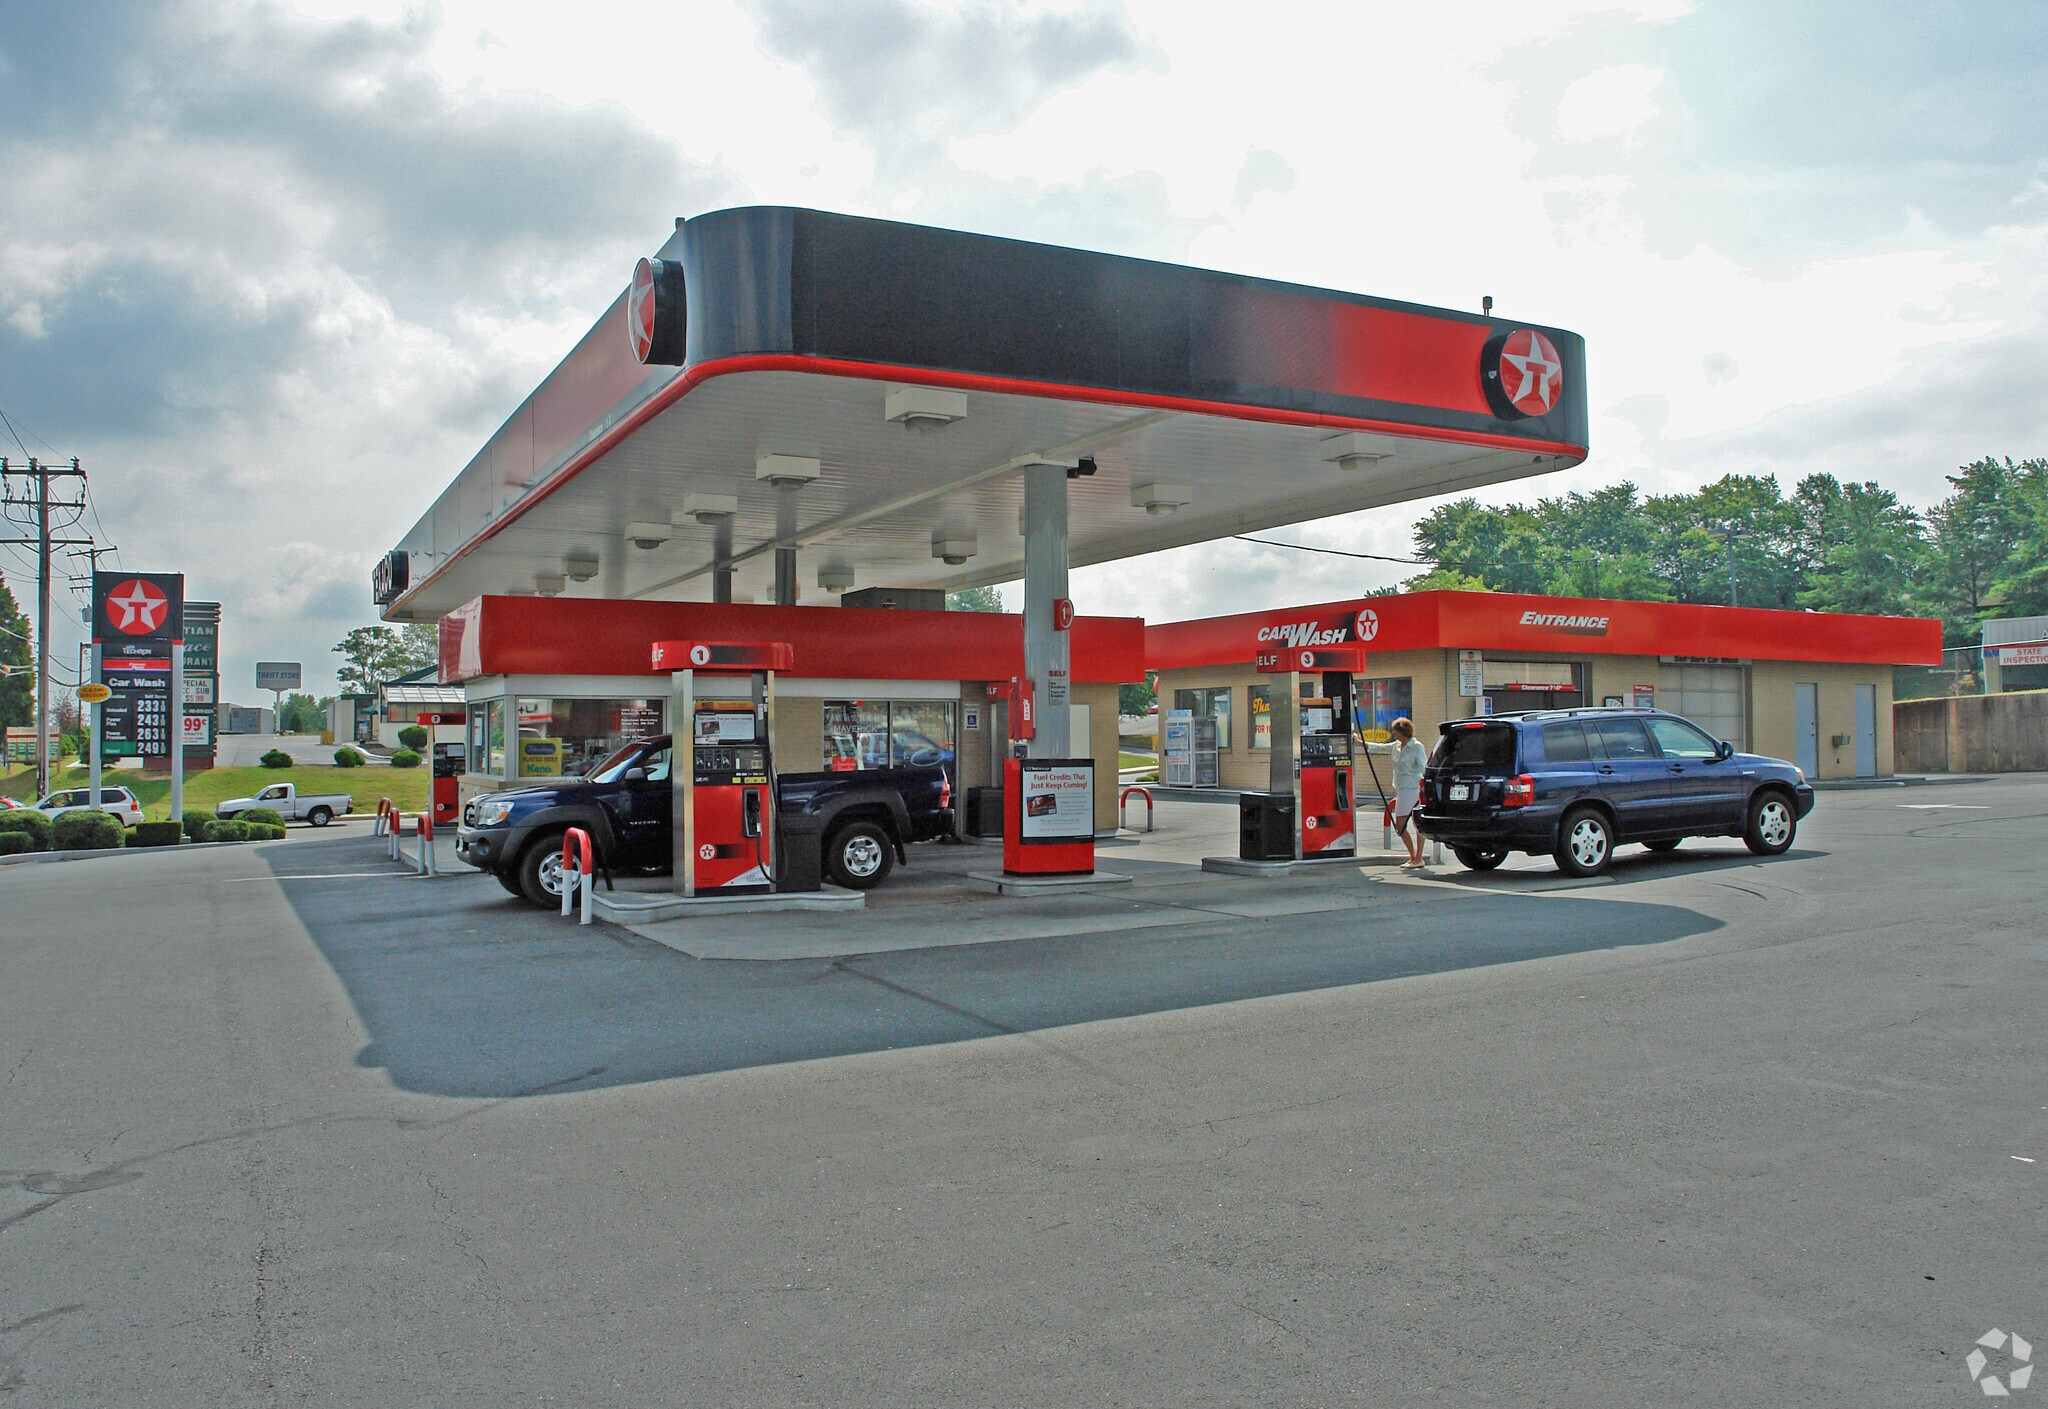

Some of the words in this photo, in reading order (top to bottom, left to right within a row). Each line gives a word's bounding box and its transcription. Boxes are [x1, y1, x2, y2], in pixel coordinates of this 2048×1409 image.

[1519, 611, 1610, 628] ENTRANCE
[696, 649, 704, 662] 1
[2016, 647, 2042, 656] STATE
[1304, 654, 1311, 664] 3
[258, 671, 279, 679] THRIFT
[280, 672, 300, 680] STORE
[108, 677, 131, 687] Car
[133, 678, 166, 687] Wash
[137, 700, 159, 713] 233
[137, 713, 159, 726] 243
[137, 728, 159, 740] 263
[833, 725, 877, 733] MAVERICK
[137, 742, 159, 754] 249
[1049, 773, 1072, 781] Credits
[1030, 782, 1044, 790] Just
[1045, 782, 1062, 790] Keep
[1063, 782, 1088, 790] Coming!
